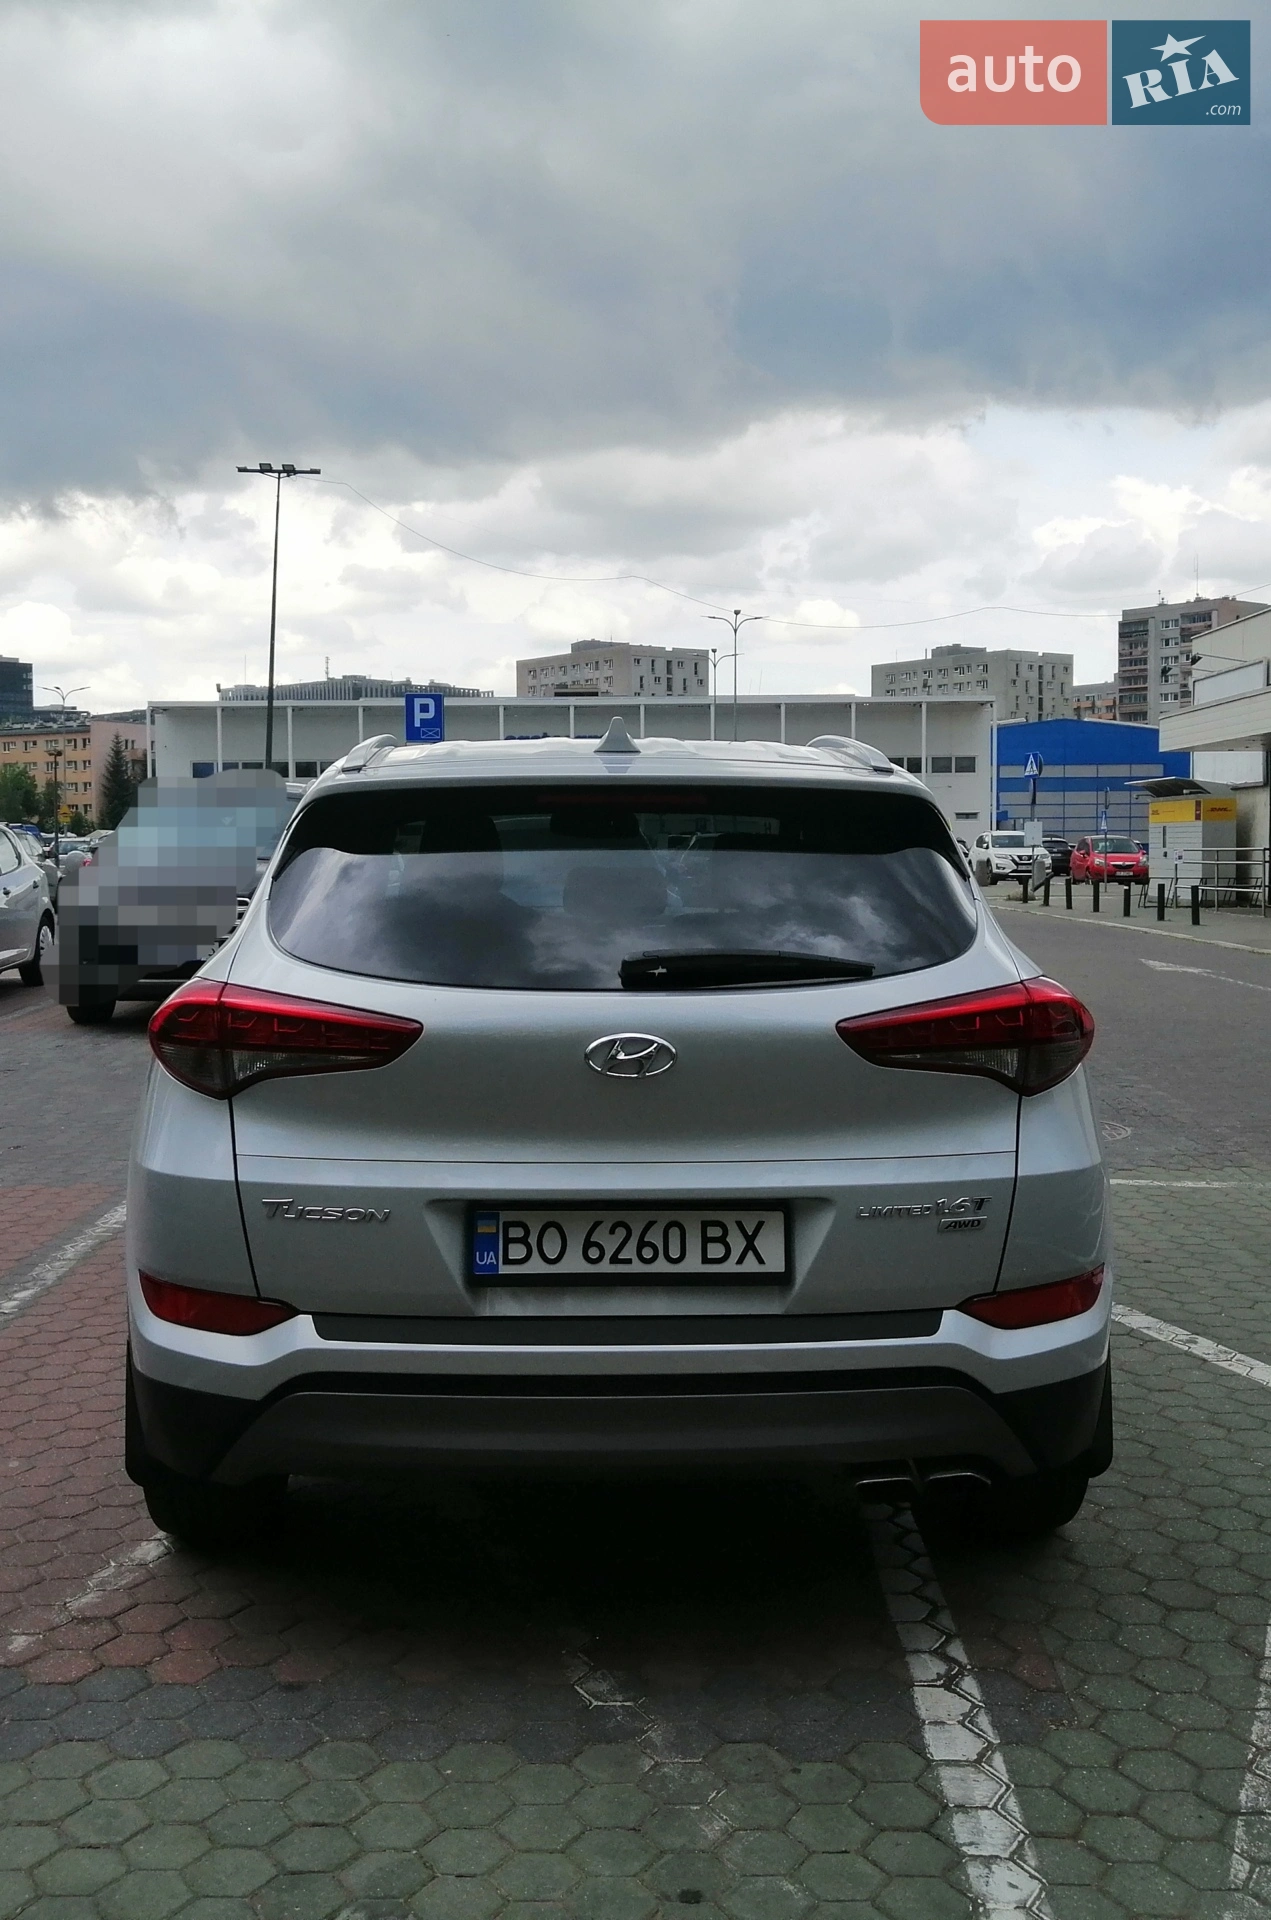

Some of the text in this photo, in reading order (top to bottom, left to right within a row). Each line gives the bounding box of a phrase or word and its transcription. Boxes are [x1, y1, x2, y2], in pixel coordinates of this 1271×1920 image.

[413, 697, 435, 728] P
[262, 1198, 391, 1222] TUCSON
[856, 1204, 934, 1219] LIMITED
[943, 1218, 982, 1230] AWD
[501, 1220, 766, 1266] BO 6260 BX
[475, 1251, 497, 1265] UA
